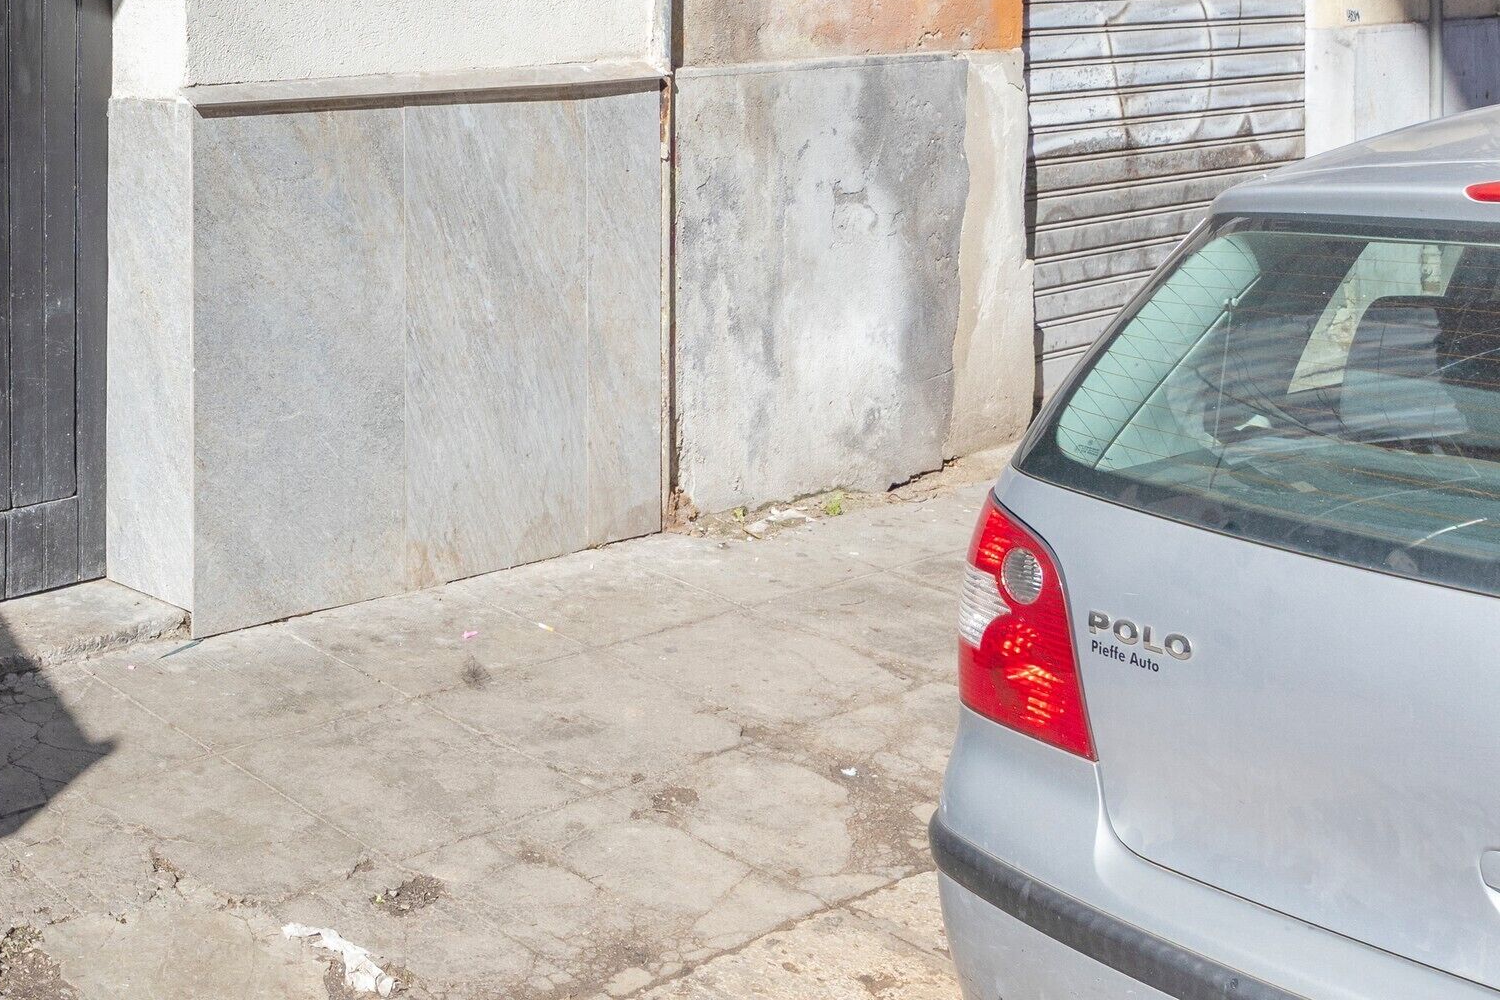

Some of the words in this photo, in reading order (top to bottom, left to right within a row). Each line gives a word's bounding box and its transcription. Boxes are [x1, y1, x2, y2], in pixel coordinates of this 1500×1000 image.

[1088, 609, 1193, 660] POLO
[1090, 640, 1126, 664] Pieffe
[1129, 651, 1160, 673] Auto
